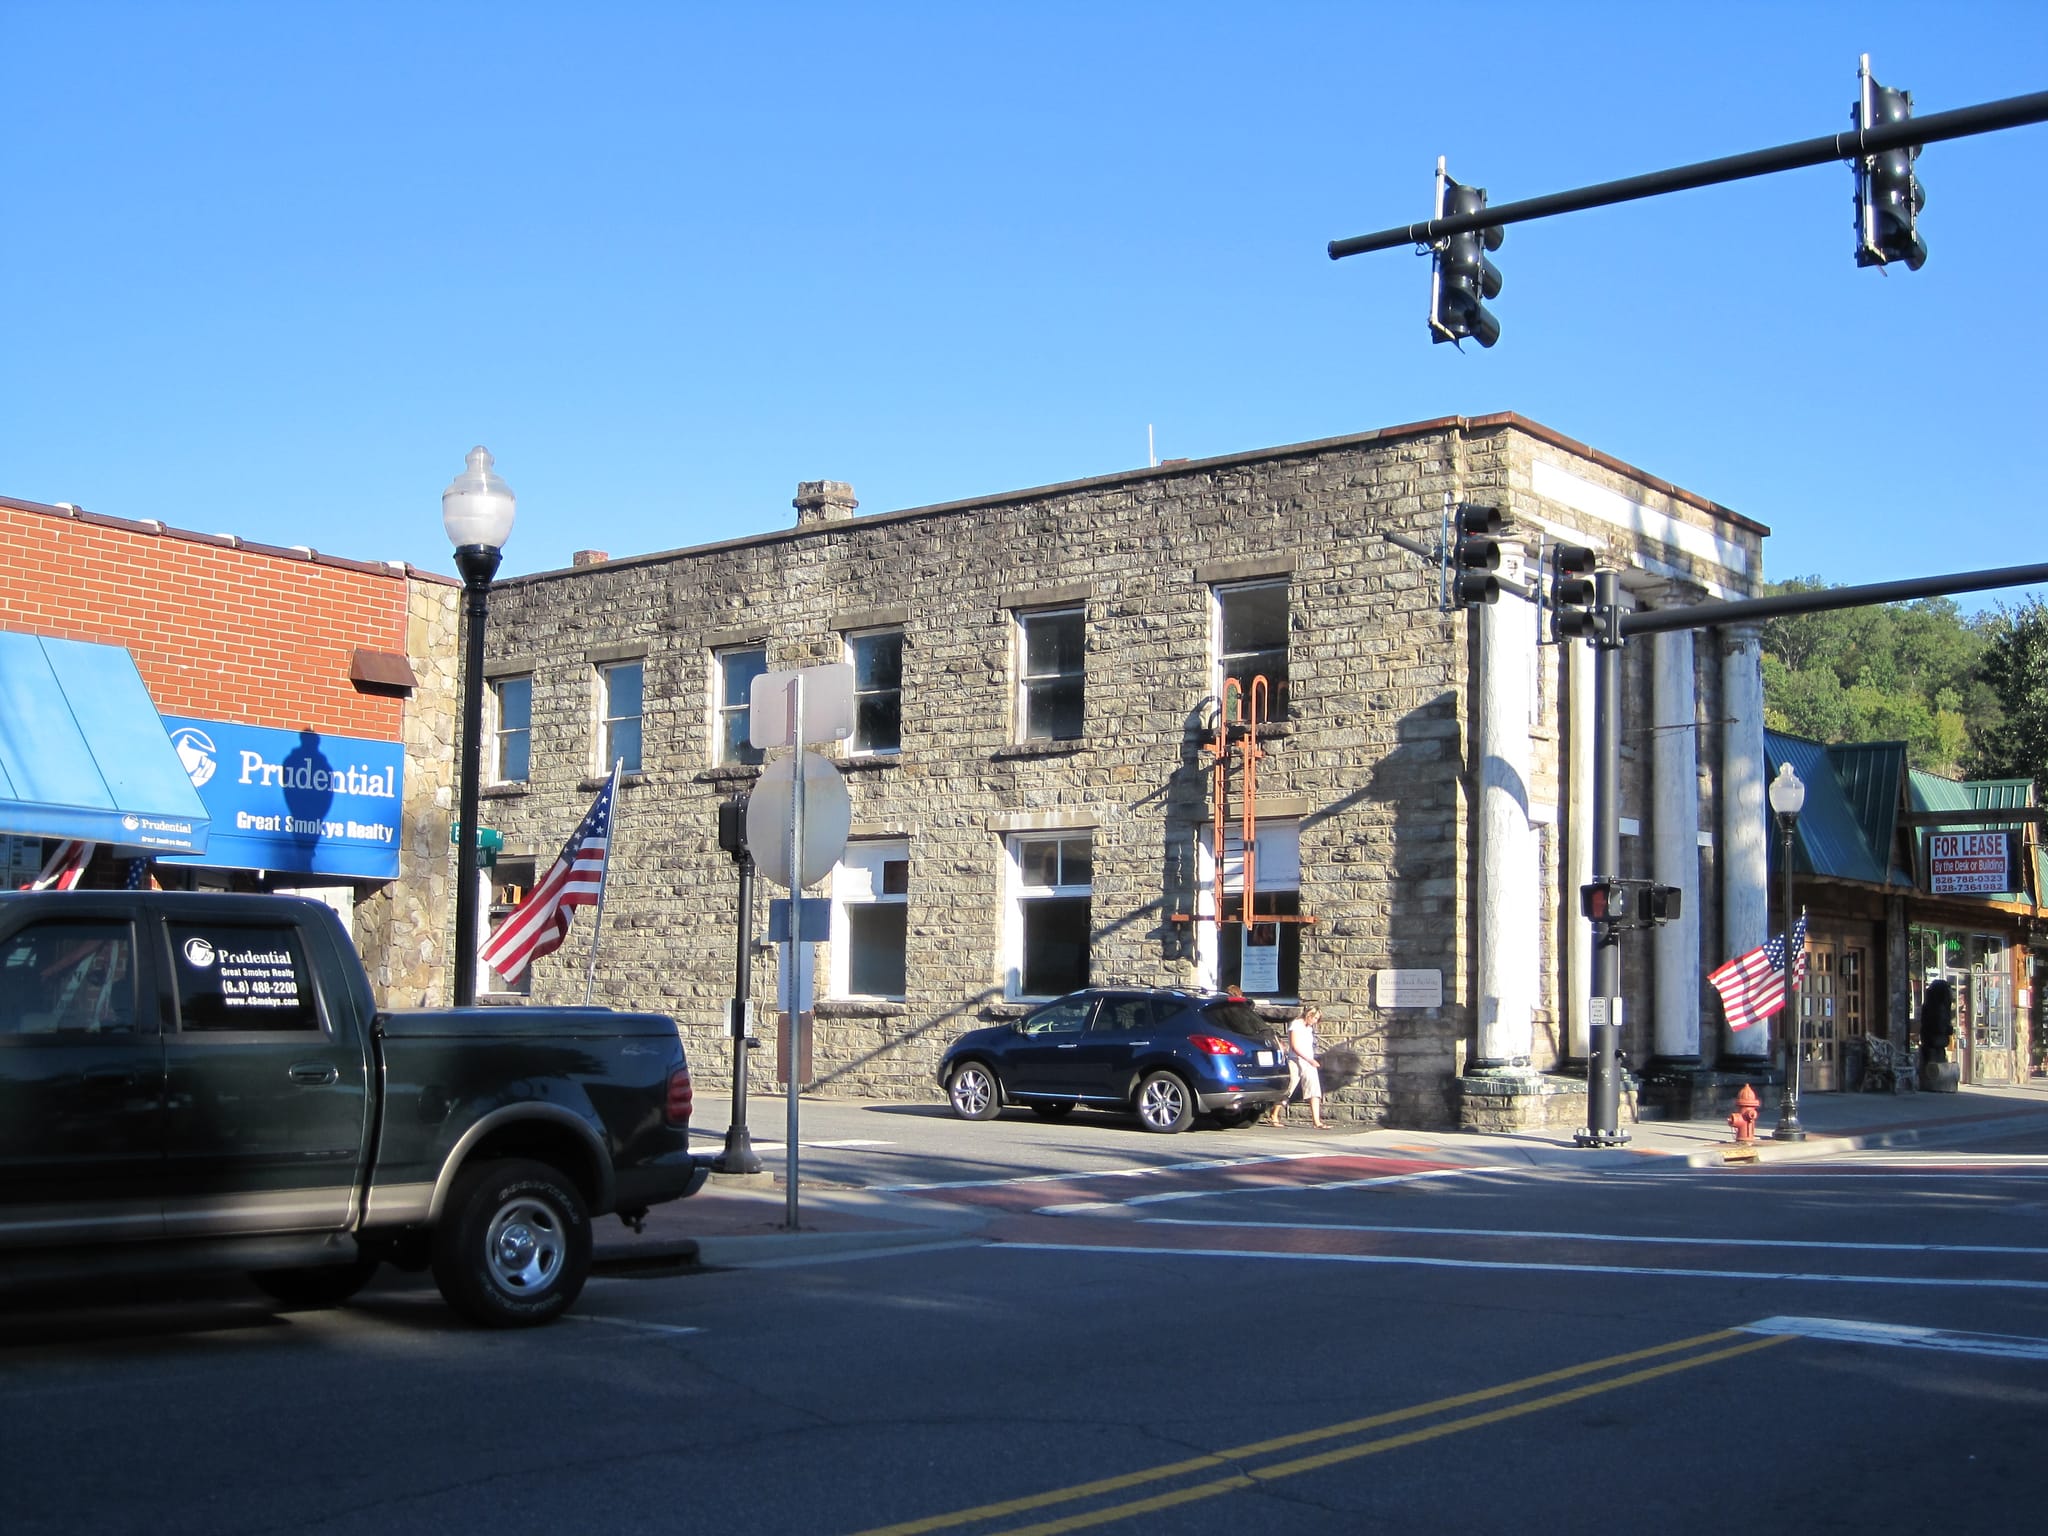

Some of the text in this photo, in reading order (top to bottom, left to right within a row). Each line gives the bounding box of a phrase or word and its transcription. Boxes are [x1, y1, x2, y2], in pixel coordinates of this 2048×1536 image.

[238, 750, 395, 798] Prudential
[141, 818, 192, 834] Prudential
[236, 811, 394, 843] Great Smokys Realty
[1934, 835, 2002, 857] FOR LEASE
[1935, 859, 2004, 873] By the Desk or Building
[218, 949, 292, 965] Prudential
[221, 967, 295, 979] Great Smokys Realty
[222, 980, 298, 994] (88) 488-2200
